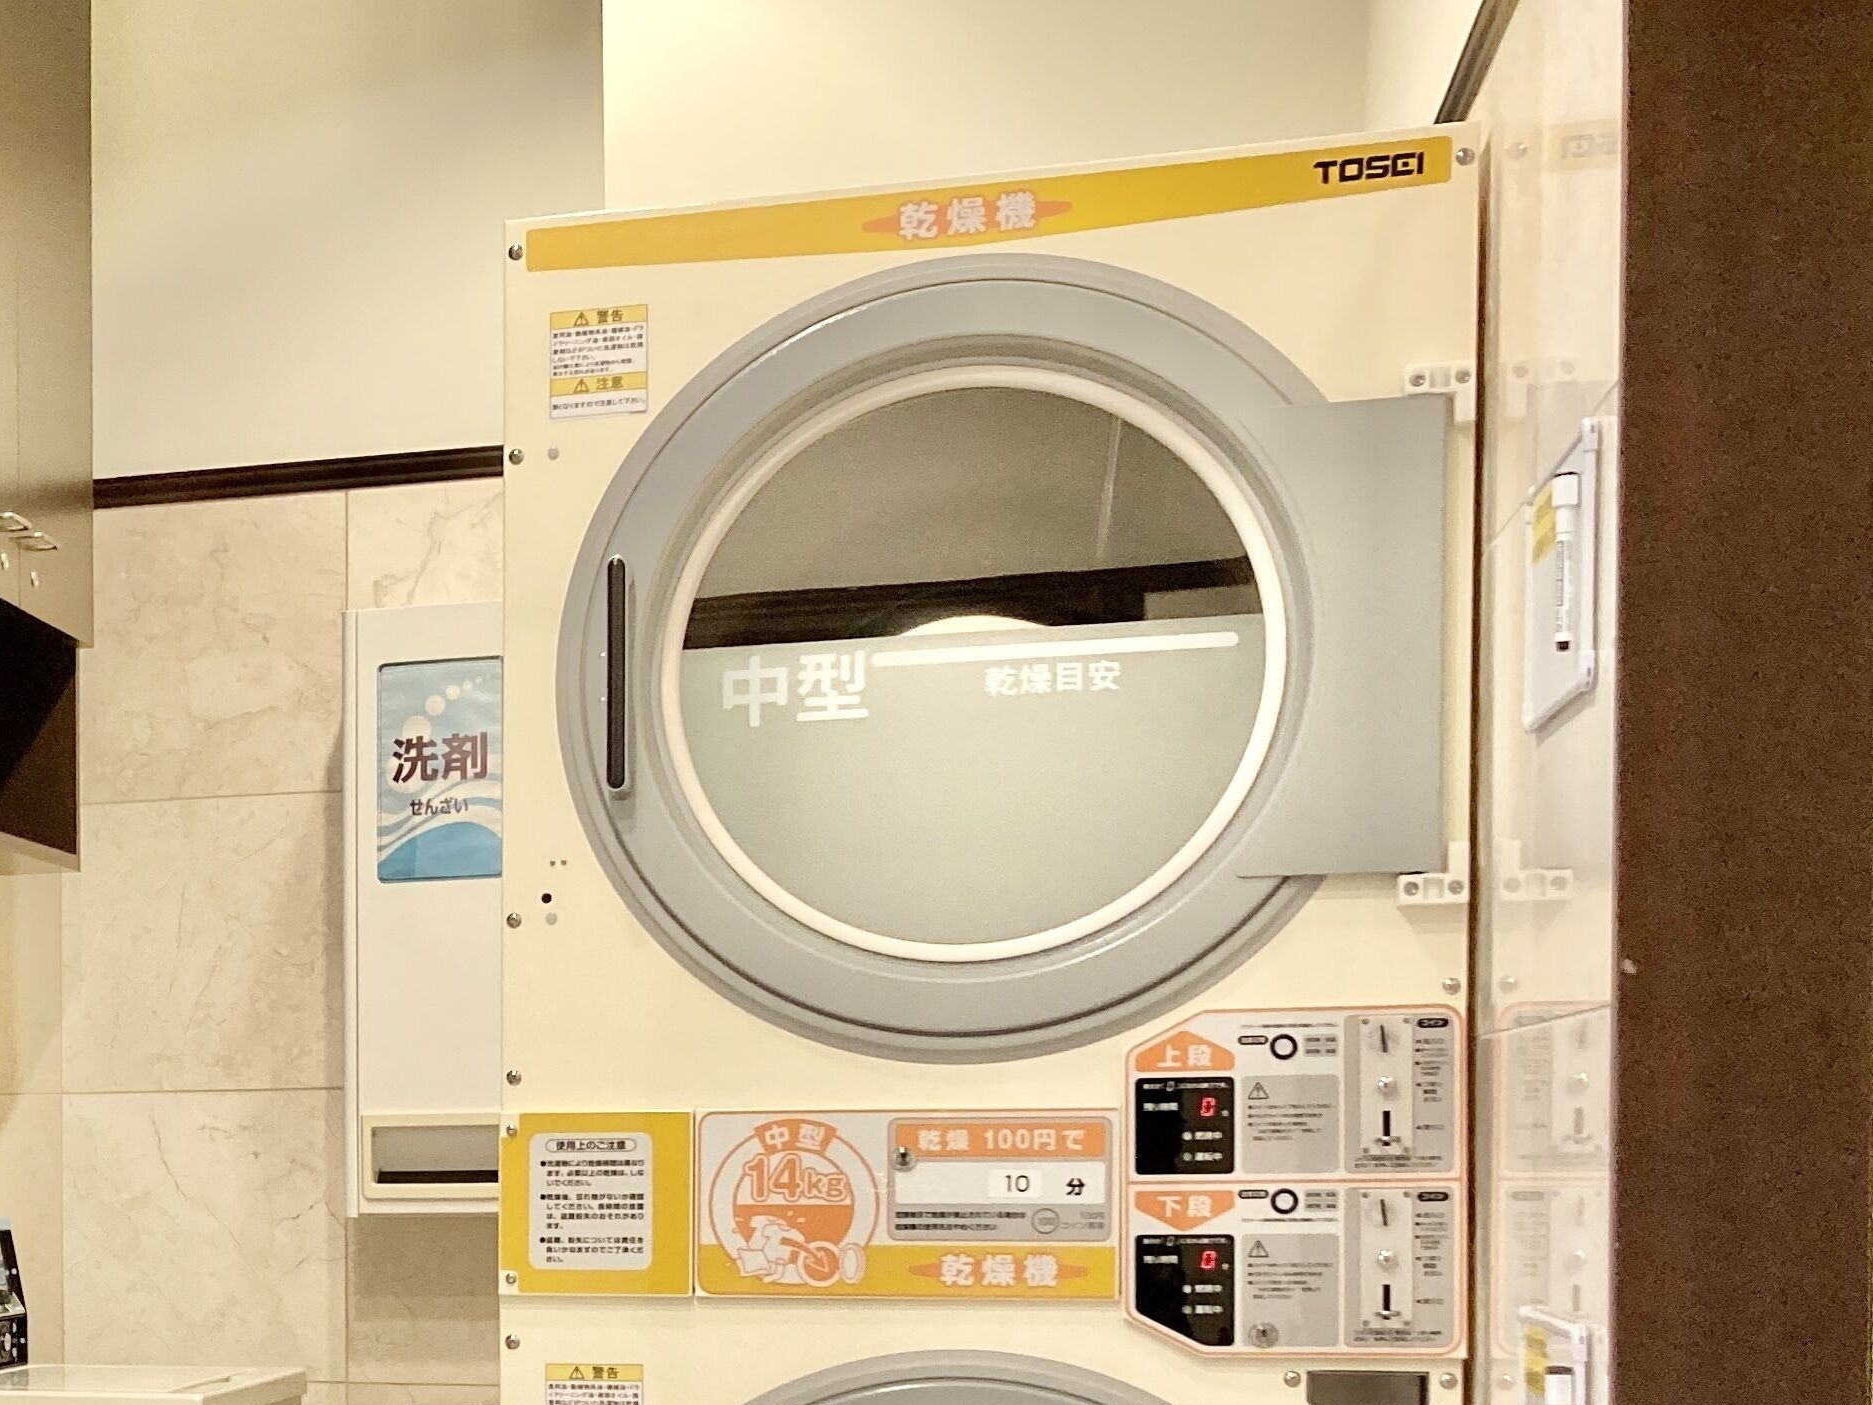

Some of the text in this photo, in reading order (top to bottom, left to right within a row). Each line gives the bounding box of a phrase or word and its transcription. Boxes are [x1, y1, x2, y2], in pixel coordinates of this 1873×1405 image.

[1314, 151, 1424, 184] TOSEI
[898, 191, 1036, 241] 乾燥機
[597, 308, 624, 324] 警告
[596, 376, 624, 390] 注意
[721, 649, 869, 728] 中型
[984, 660, 1122, 697] 乾燥目安
[392, 731, 489, 785] 洗剤
[409, 797, 469, 816] せんざい
[1156, 1044, 1214, 1068] 上段
[556, 1140, 626, 1151] 使用上のご注意
[764, 1123, 826, 1150] 中型
[917, 1127, 1087, 1151] 乾燥 100円で
[744, 1154, 846, 1201] 14kg
[1003, 1174, 1086, 1197] 10 分
[1156, 1195, 1214, 1219] 下段
[940, 1254, 1060, 1288] 乾燥機
[592, 1366, 620, 1380] 警告
